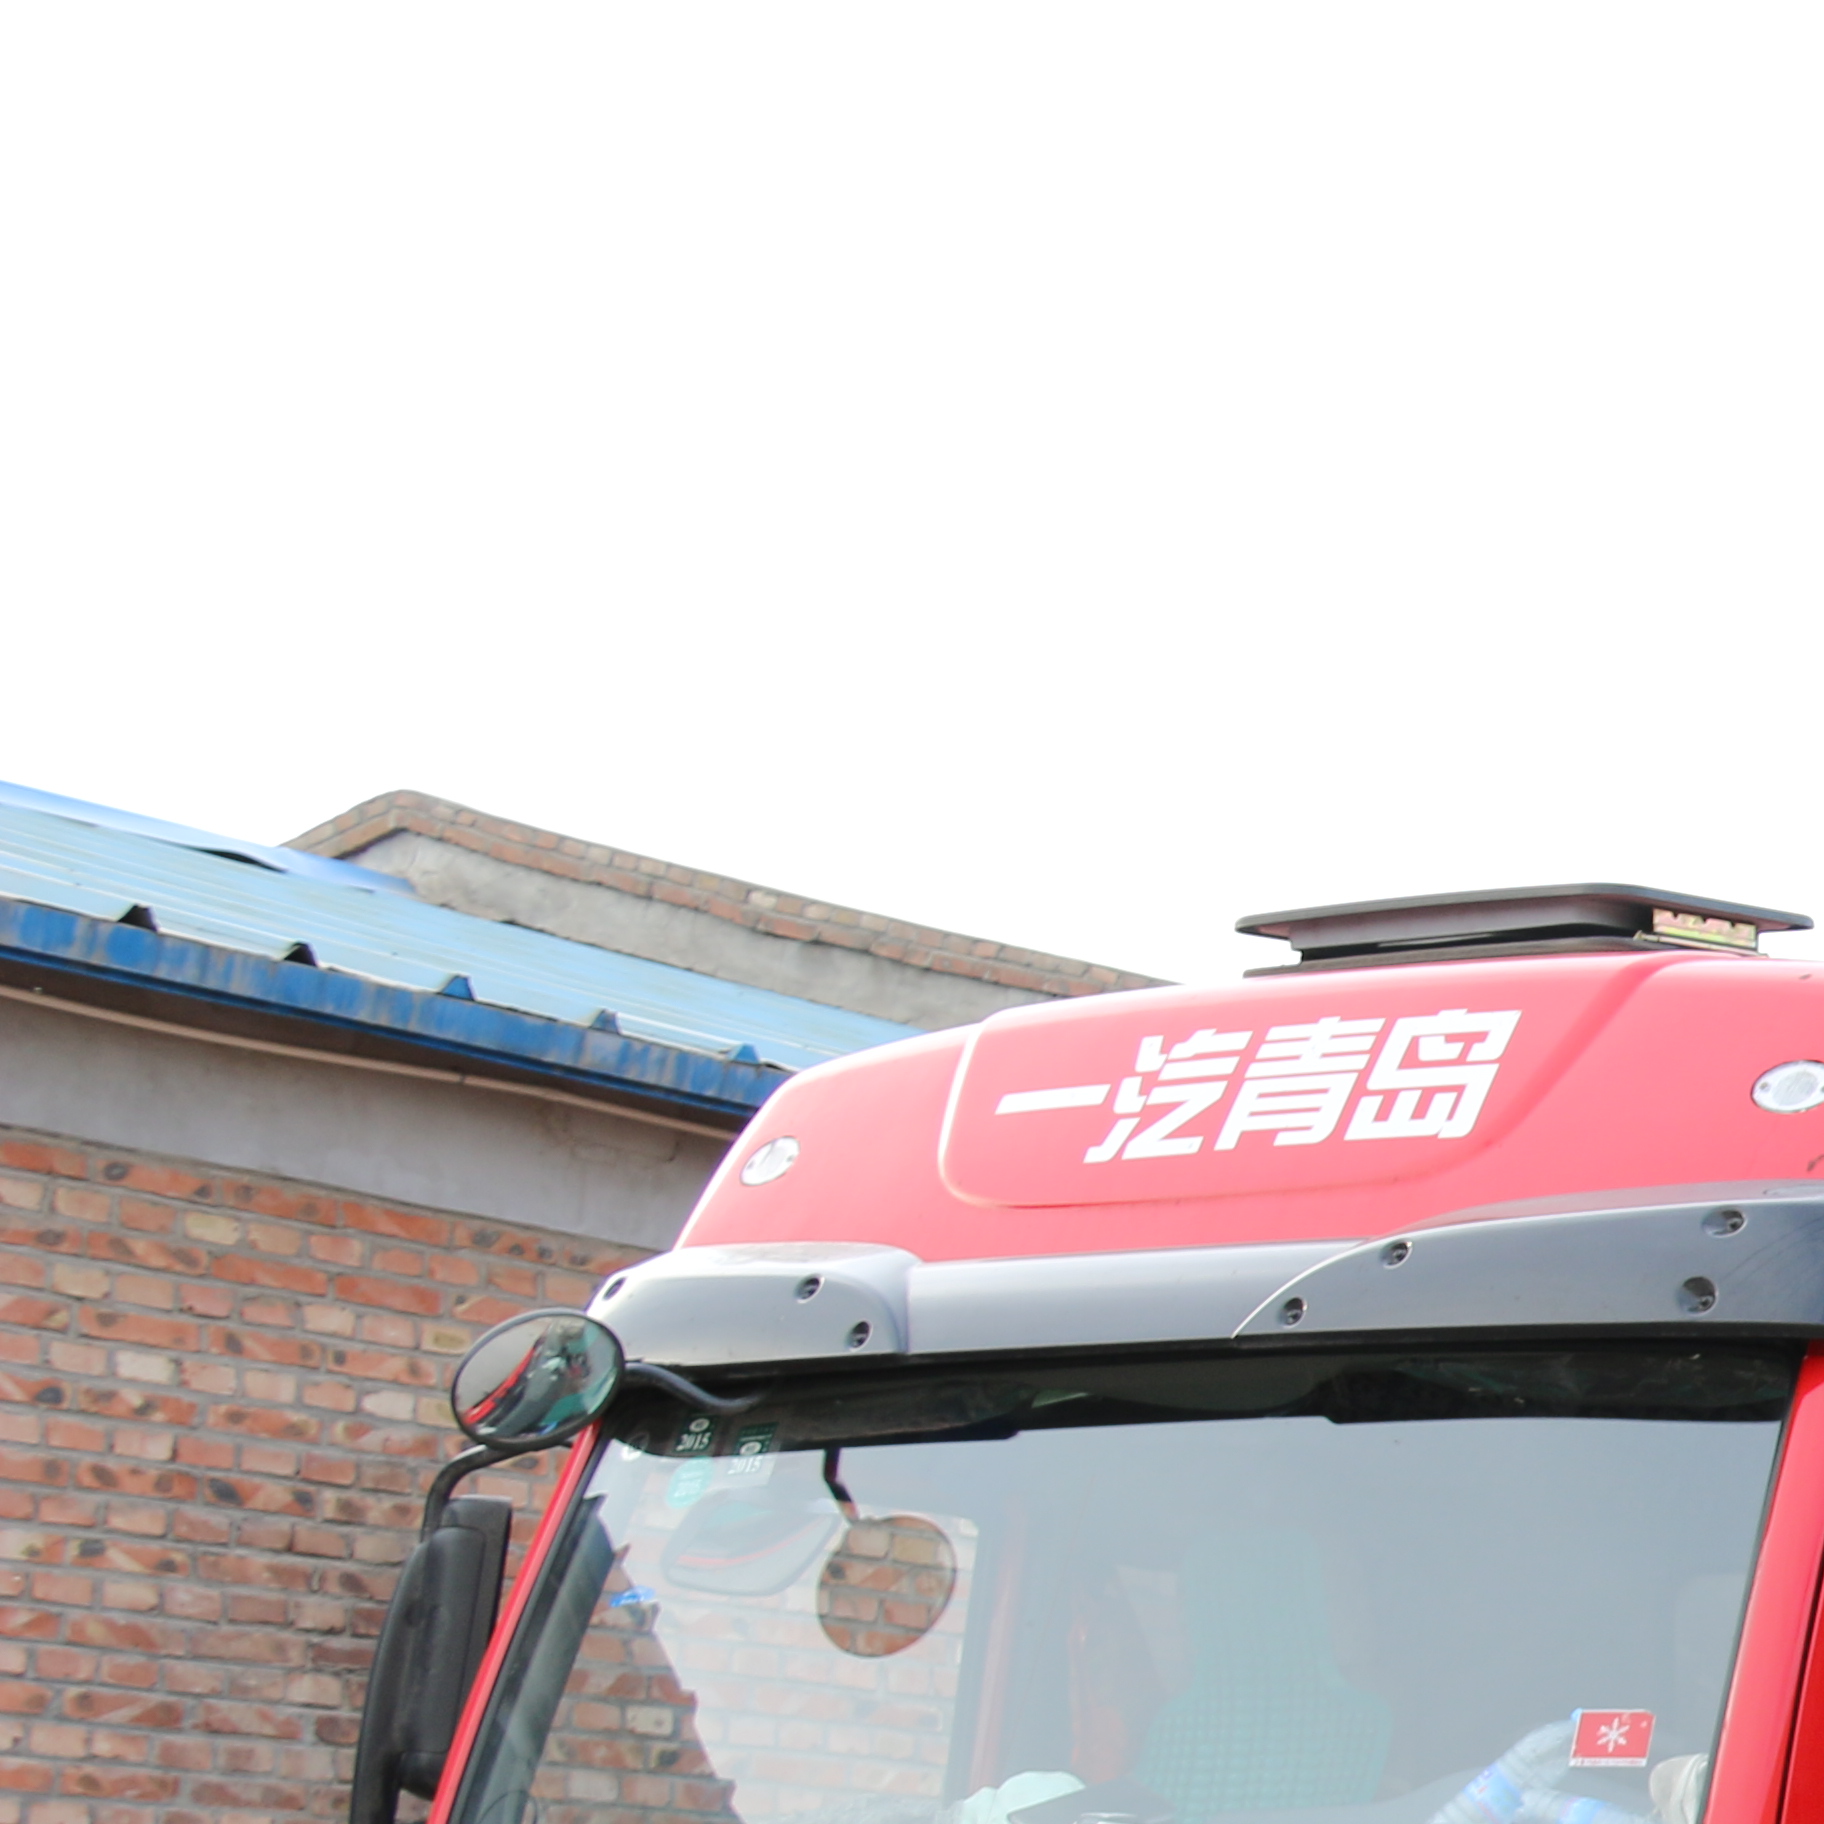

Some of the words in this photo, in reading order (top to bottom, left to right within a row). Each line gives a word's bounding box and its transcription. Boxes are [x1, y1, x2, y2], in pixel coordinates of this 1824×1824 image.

[995, 1009, 1522, 1163] 一汽青岛
[676, 1431, 712, 1451] 2015
[728, 1455, 763, 1475] 2015
